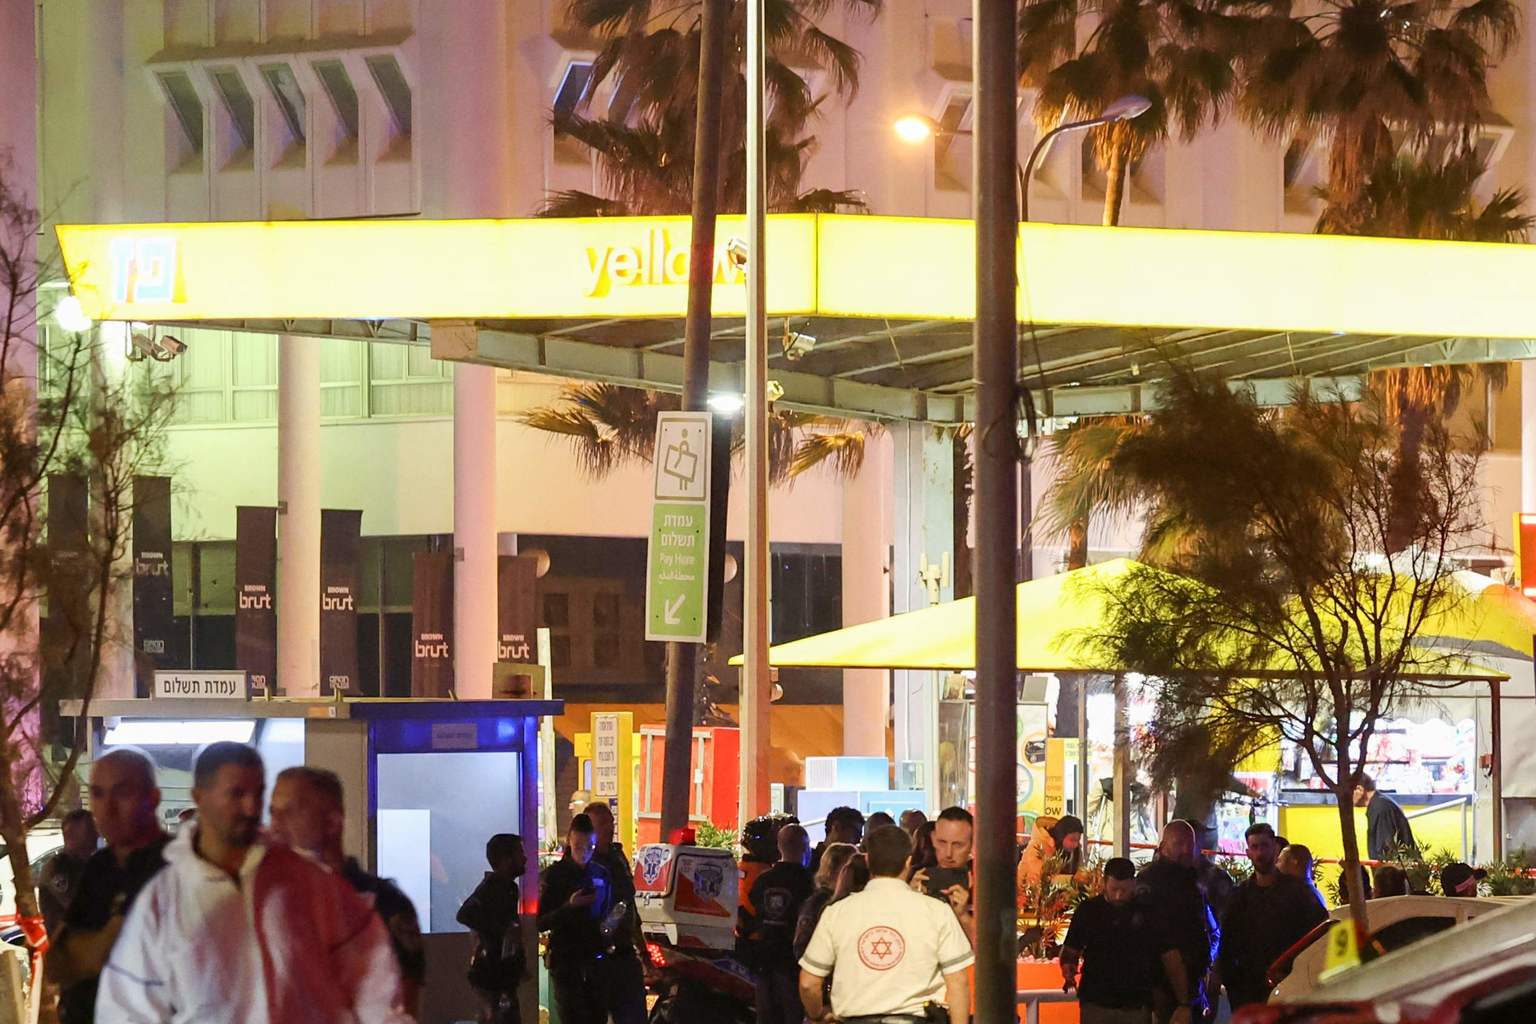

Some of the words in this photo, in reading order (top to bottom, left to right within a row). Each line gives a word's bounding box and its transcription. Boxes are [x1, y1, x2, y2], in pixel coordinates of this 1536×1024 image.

[664, 514, 693, 528] עמדת
[661, 531, 695, 547] תשלום
[240, 592, 271, 609] brut
[322, 593, 353, 610] brut
[415, 640, 449, 658] brut
[498, 641, 530, 659] brut
[164, 676, 200, 694] תשלום
[205, 680, 236, 695] עמדת
